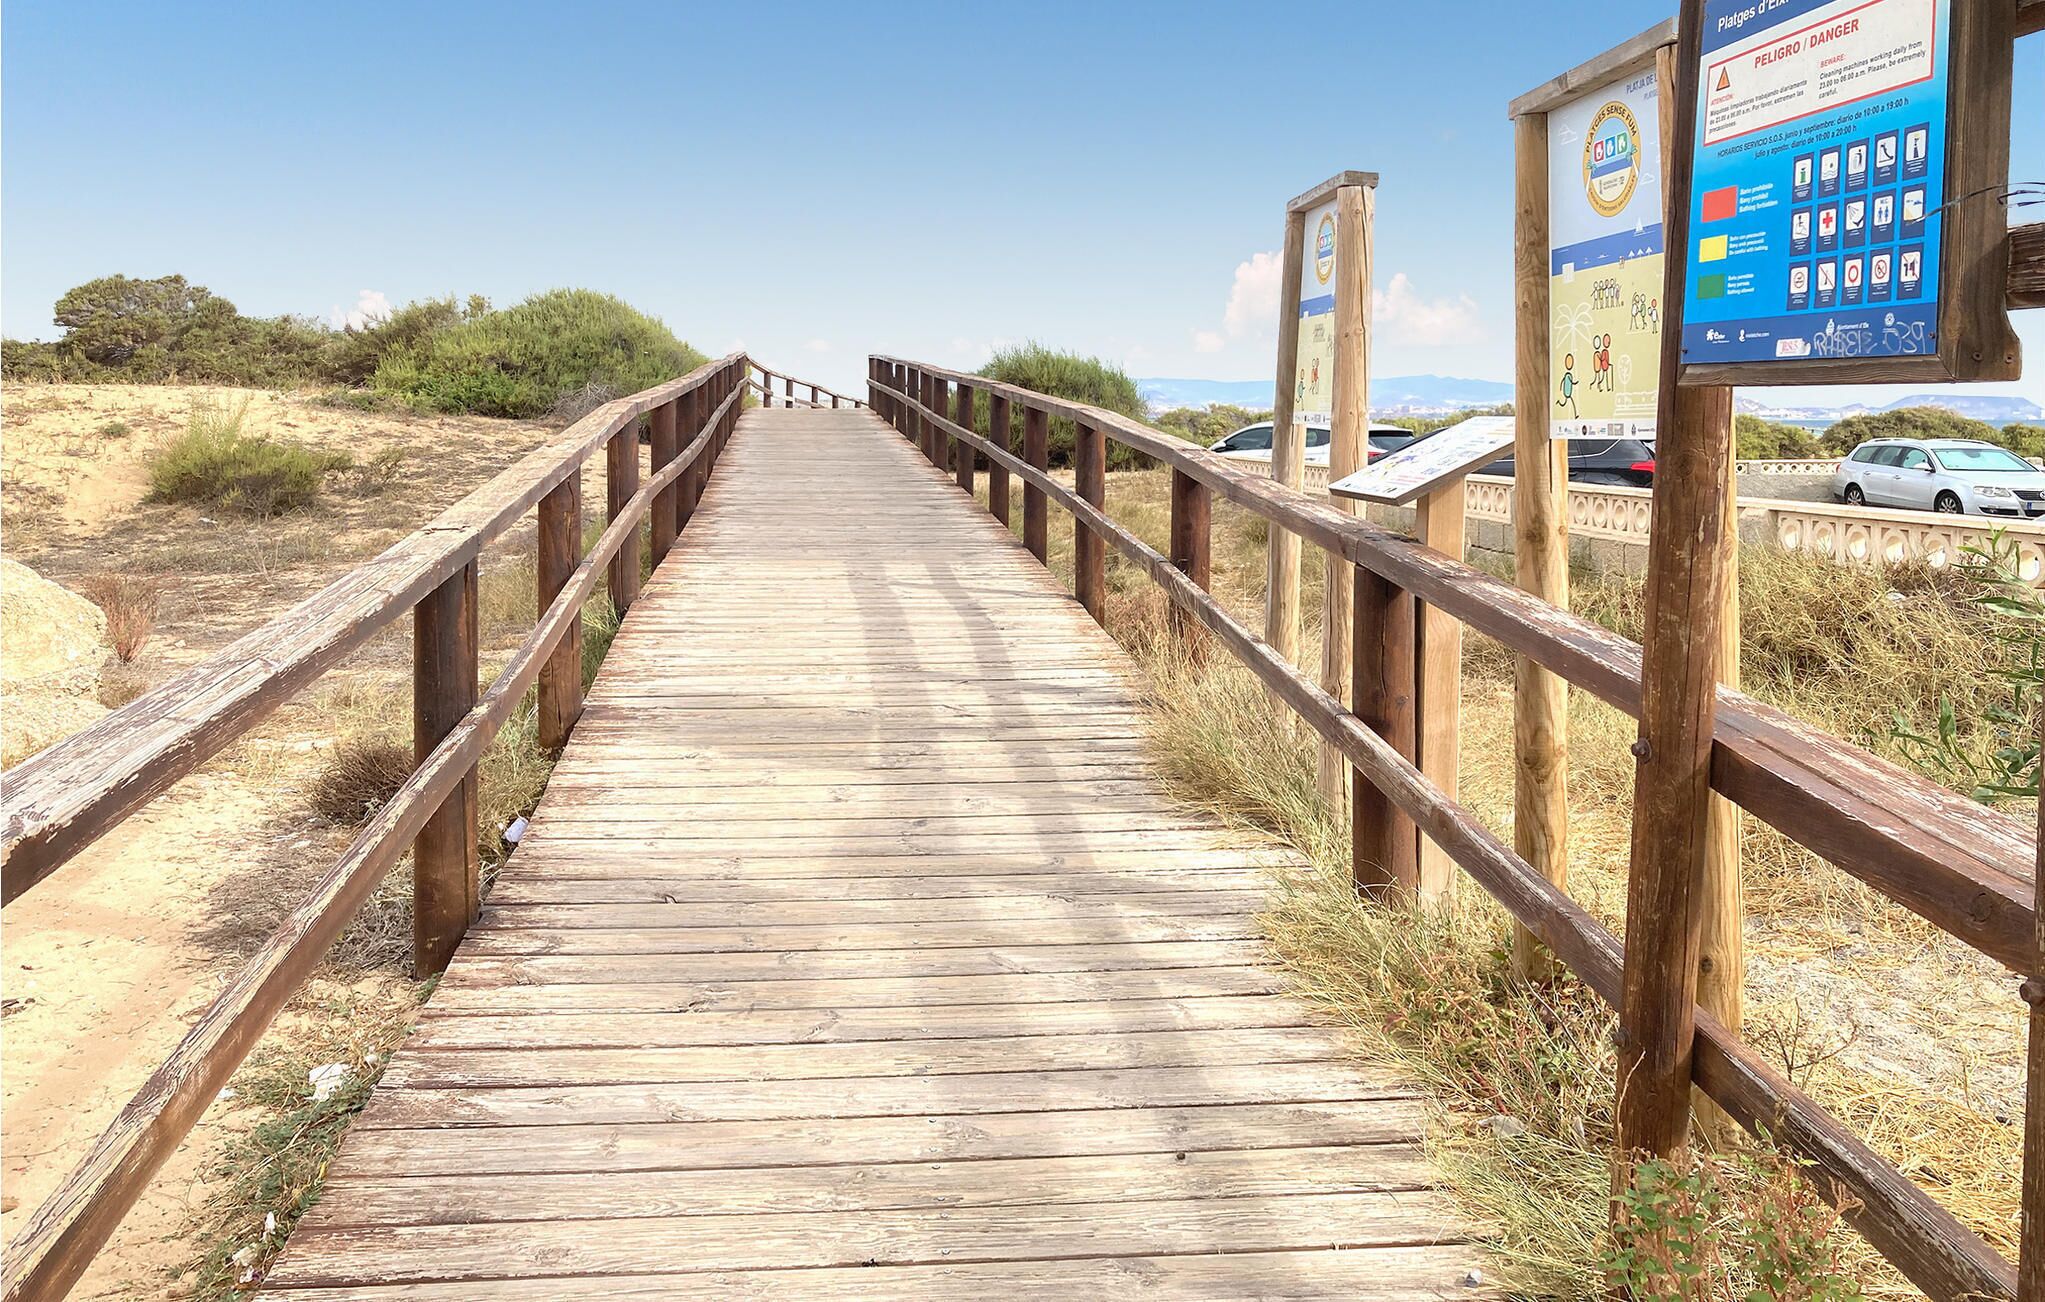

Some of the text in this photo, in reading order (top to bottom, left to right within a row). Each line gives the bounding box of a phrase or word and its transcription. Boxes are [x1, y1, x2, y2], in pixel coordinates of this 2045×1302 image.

[1718, 7, 1755, 32] Platges
[1754, 41, 1800, 68] PELIGRO
[1810, 18, 1859, 48] DANGER
[1843, 59, 1868, 72] machines
[1870, 51, 1892, 62] working
[1893, 46, 1907, 56] daily
[1908, 41, 1922, 50] from
[1897, 50, 1926, 64] extremely
[1606, 105, 1626, 118] SENSE
[1625, 113, 1637, 136] FUM
[1717, 144, 1743, 157] HORARIOS
[1744, 138, 1768, 151] SERVICIO
[1863, 105, 1880, 117] 10:00
